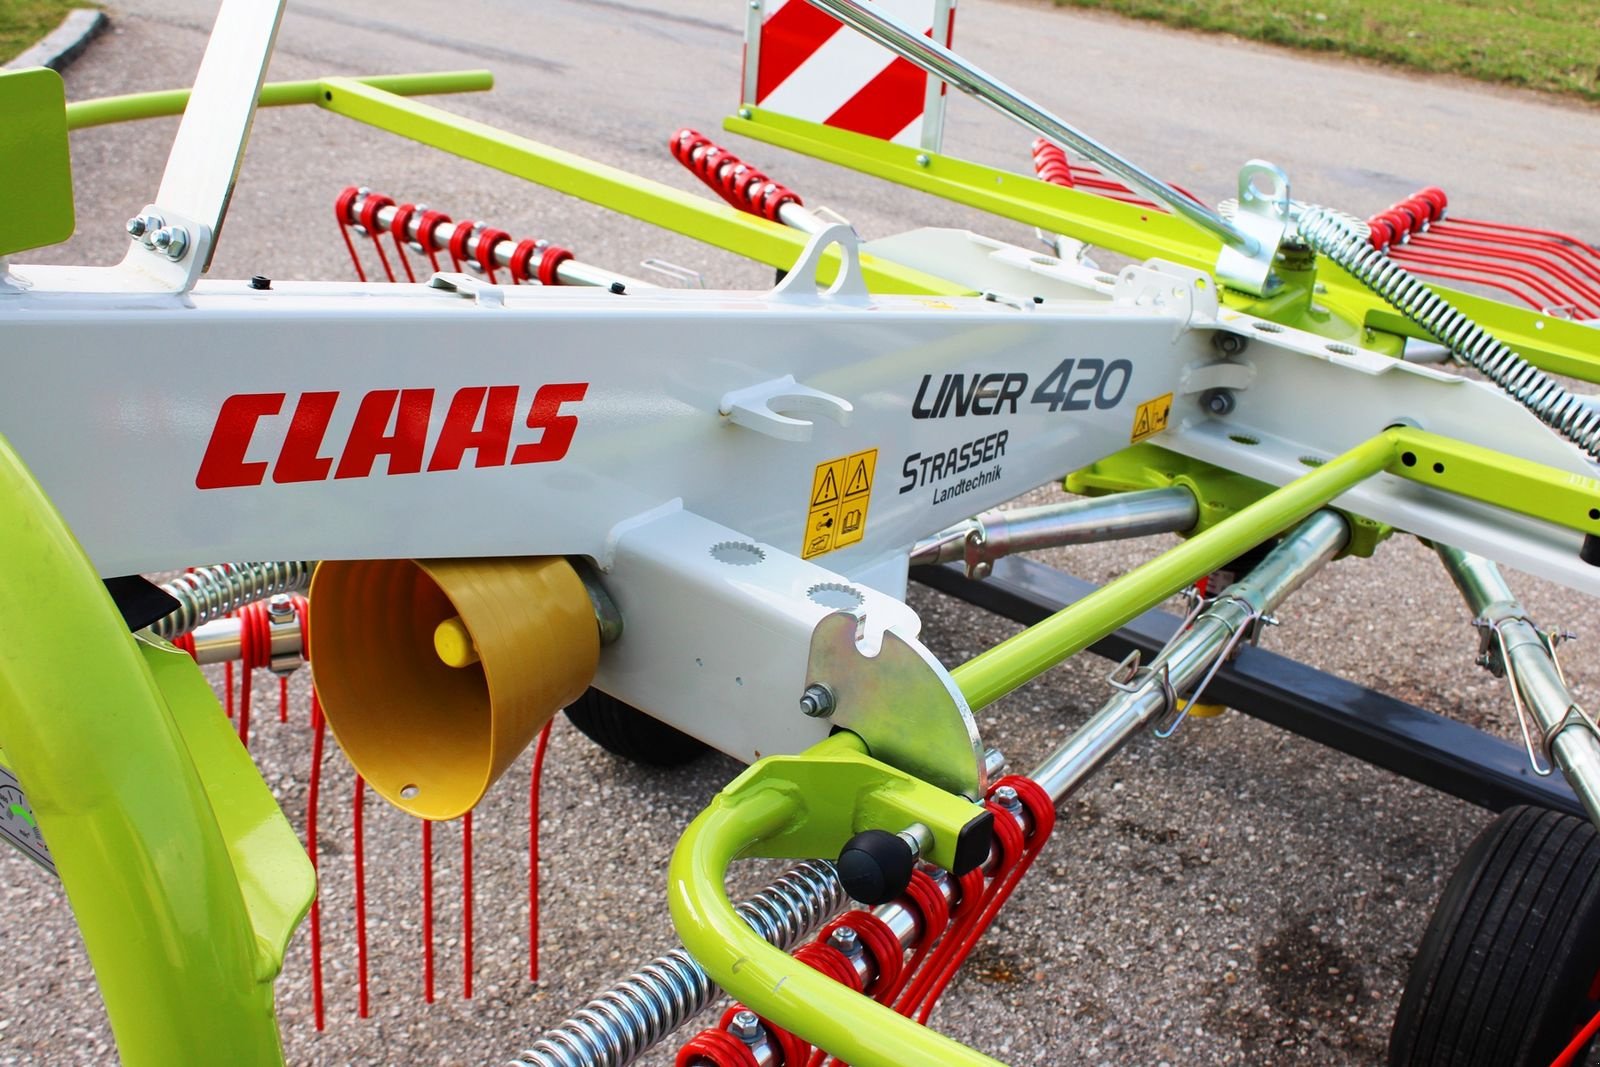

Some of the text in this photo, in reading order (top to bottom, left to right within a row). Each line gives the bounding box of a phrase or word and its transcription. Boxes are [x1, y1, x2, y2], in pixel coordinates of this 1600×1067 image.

[911, 358, 1133, 419] LINER 420
[195, 383, 589, 490] CLAAS
[899, 429, 1009, 494] STRASSER
[932, 465, 1003, 505] Landtechnik
